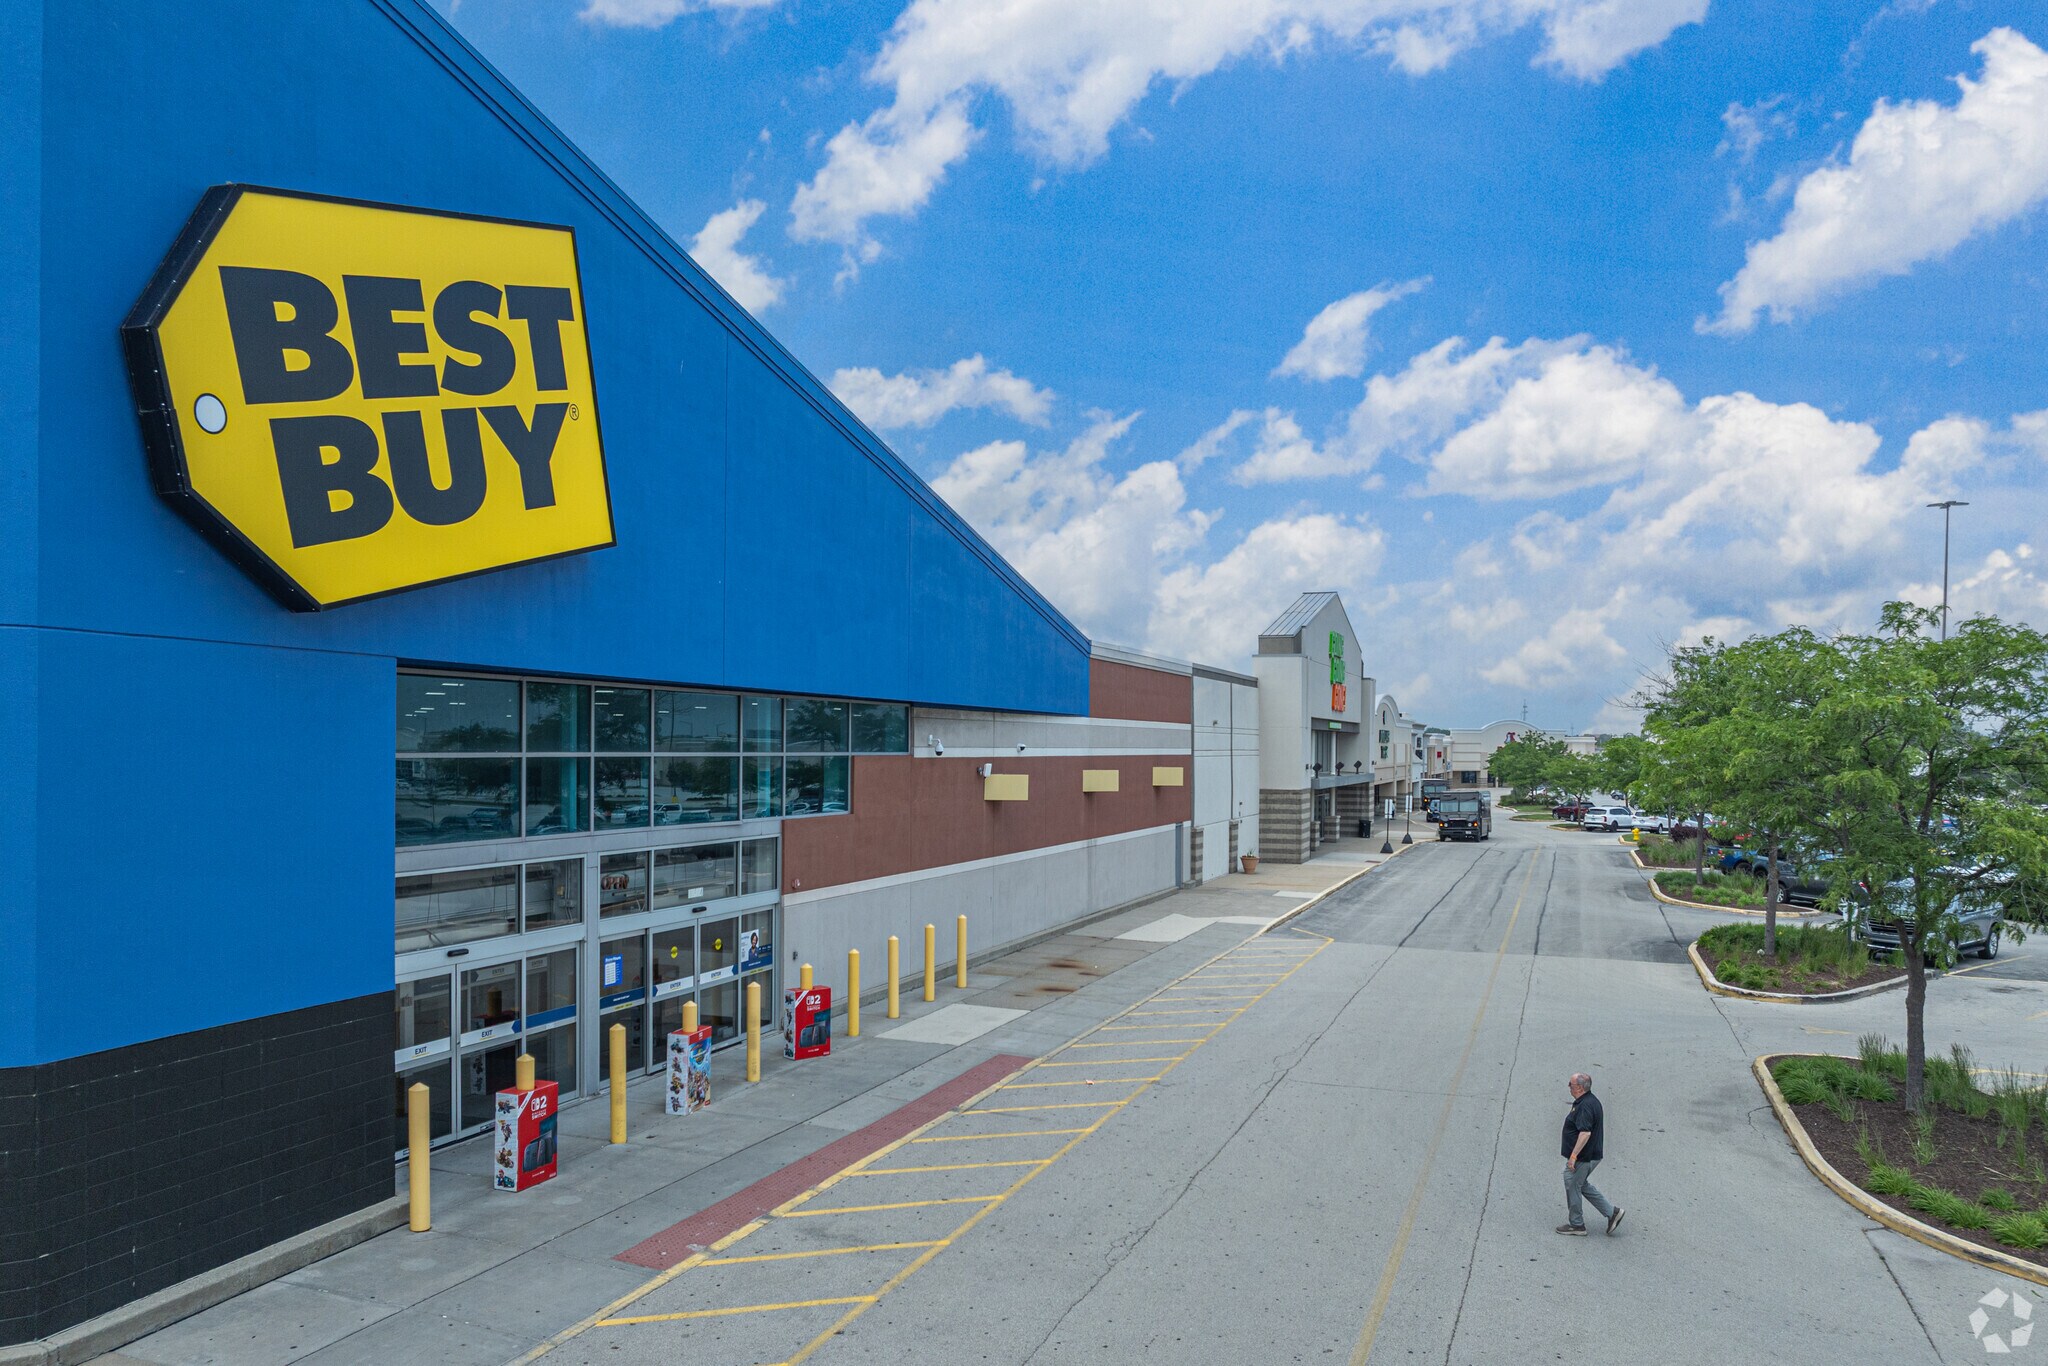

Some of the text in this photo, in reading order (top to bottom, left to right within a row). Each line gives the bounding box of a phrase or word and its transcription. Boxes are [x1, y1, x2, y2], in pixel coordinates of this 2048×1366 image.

[218, 265, 575, 405] BEST
[268, 403, 570, 549] BUY
[711, 971, 722, 979] ENTER
[670, 981, 681, 989] ENTER
[814, 994, 821, 1005] 2
[481, 1029, 493, 1038] EXIT
[415, 1046, 427, 1055] EXIT
[540, 1095, 547, 1109] 2
